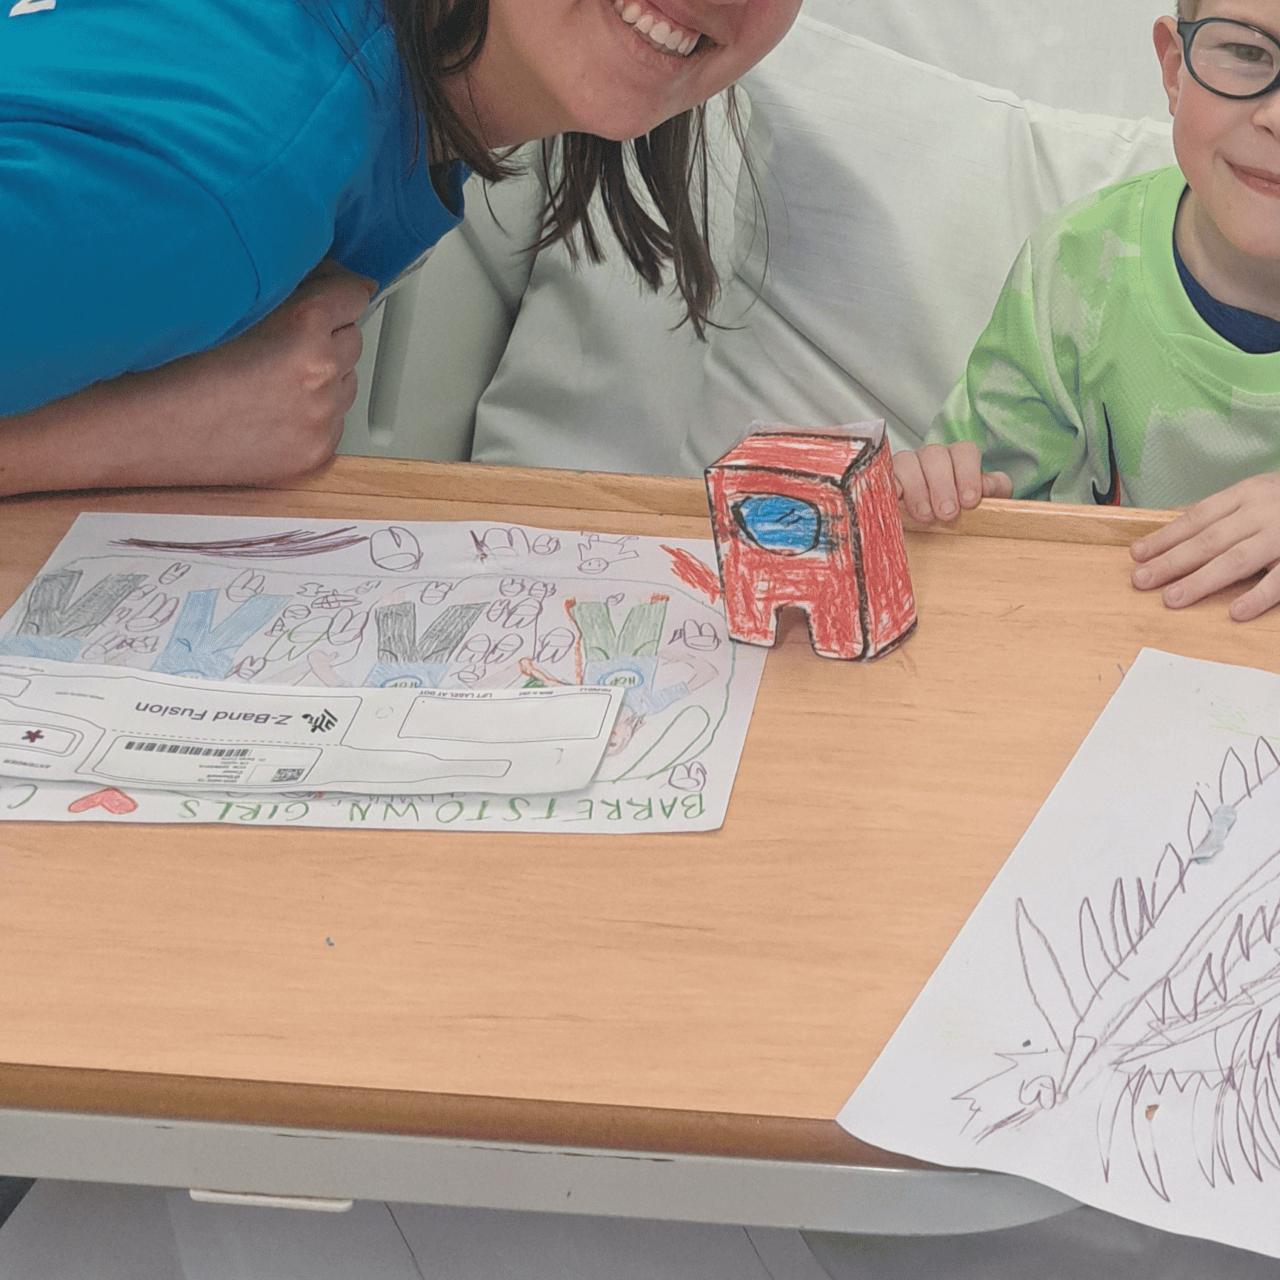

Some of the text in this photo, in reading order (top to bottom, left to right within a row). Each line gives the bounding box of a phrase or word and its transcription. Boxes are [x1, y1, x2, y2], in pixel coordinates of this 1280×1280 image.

[135, 702, 293, 726] Z-Band Fusion
[179, 800, 310, 821] GIRLS
[350, 793, 704, 823] BARRETSTOWN
